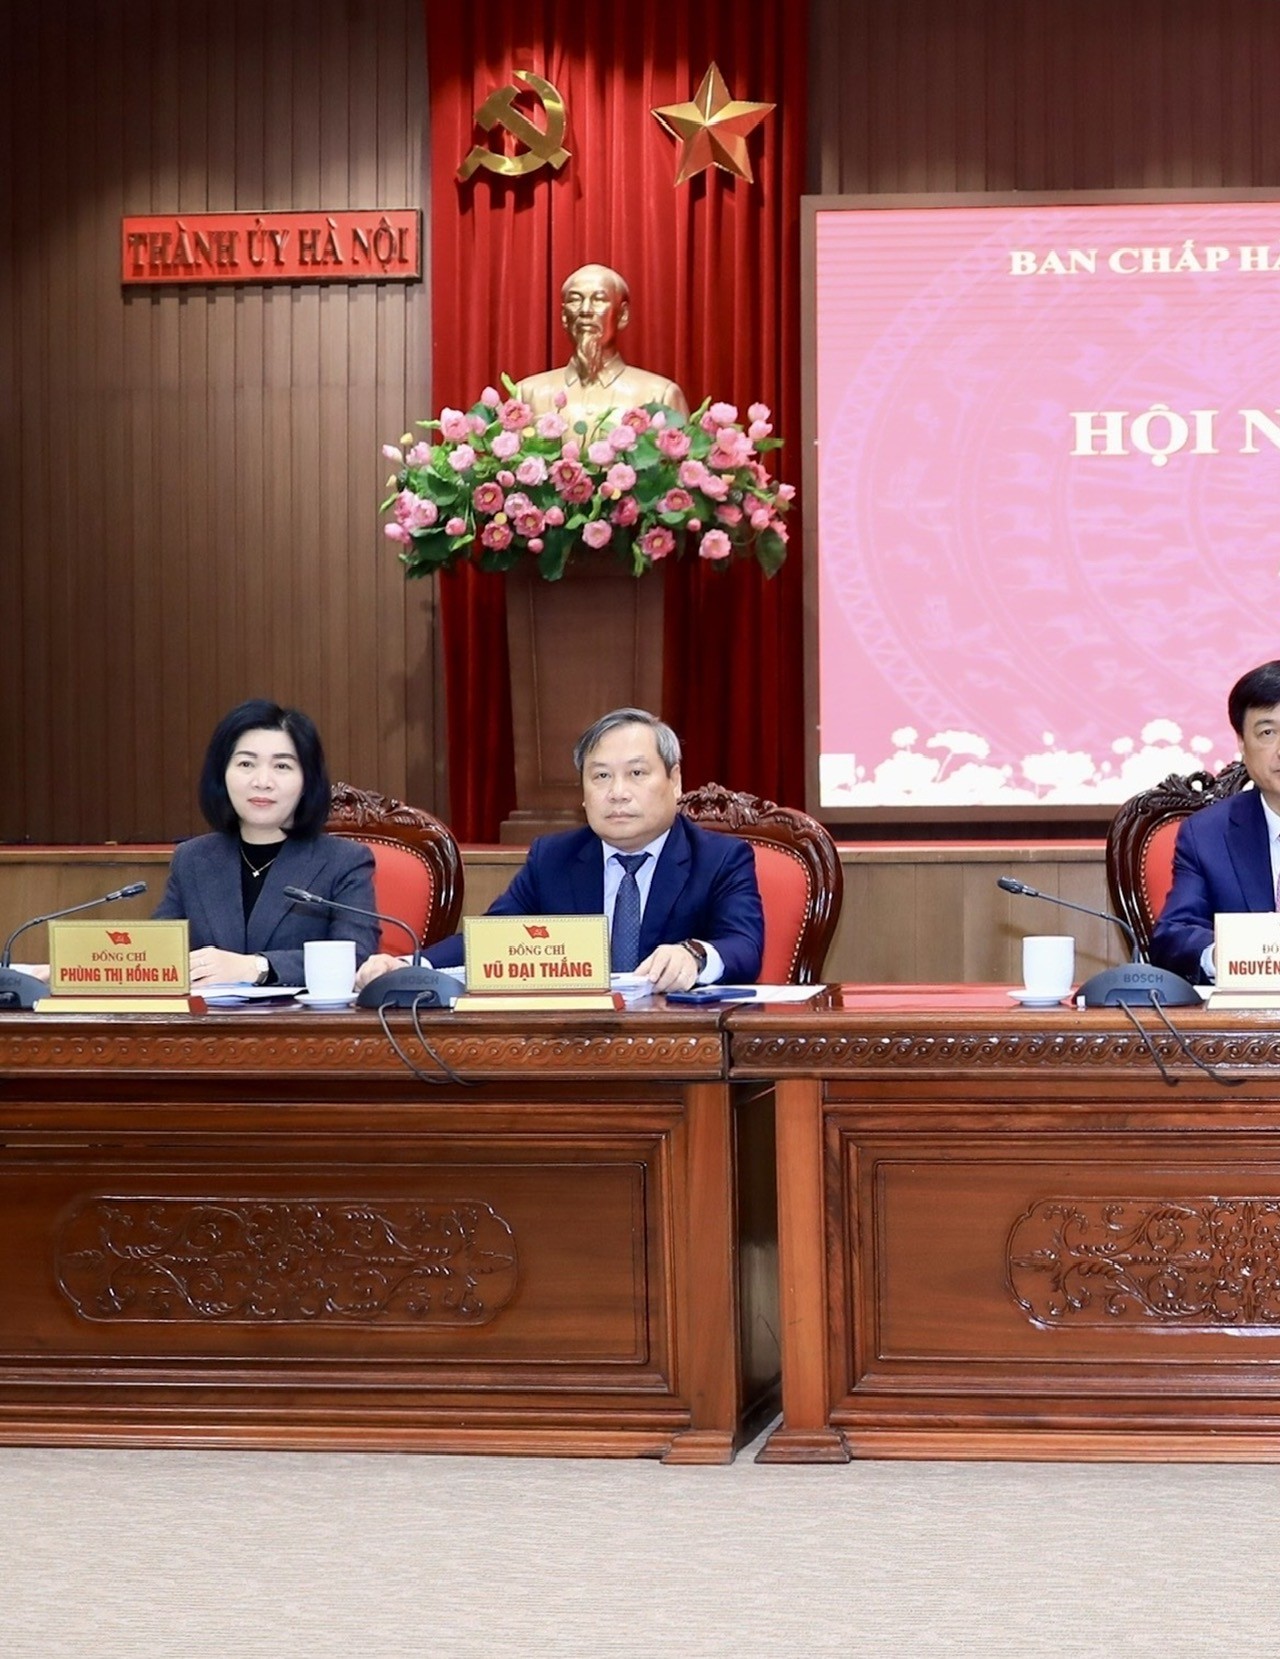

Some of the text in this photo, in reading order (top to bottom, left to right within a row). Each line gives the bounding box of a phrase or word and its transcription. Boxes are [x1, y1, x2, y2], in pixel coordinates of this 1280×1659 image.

[128, 216, 410, 274] THÀNH ỦY HÀ NỘI
[1008, 249, 1098, 276] BAN
[1108, 239, 1230, 274] CHẤP
[1069, 403, 1220, 467] HỘI
[60, 964, 102, 982] PHÙNG
[104, 967, 123, 986] THỊ
[162, 964, 179, 982] HÀ
[401, 974, 440, 985] BOSCH
[483, 956, 593, 982] VŨ ĐẠI THẮNG
[1123, 973, 1165, 984] BOSCH
